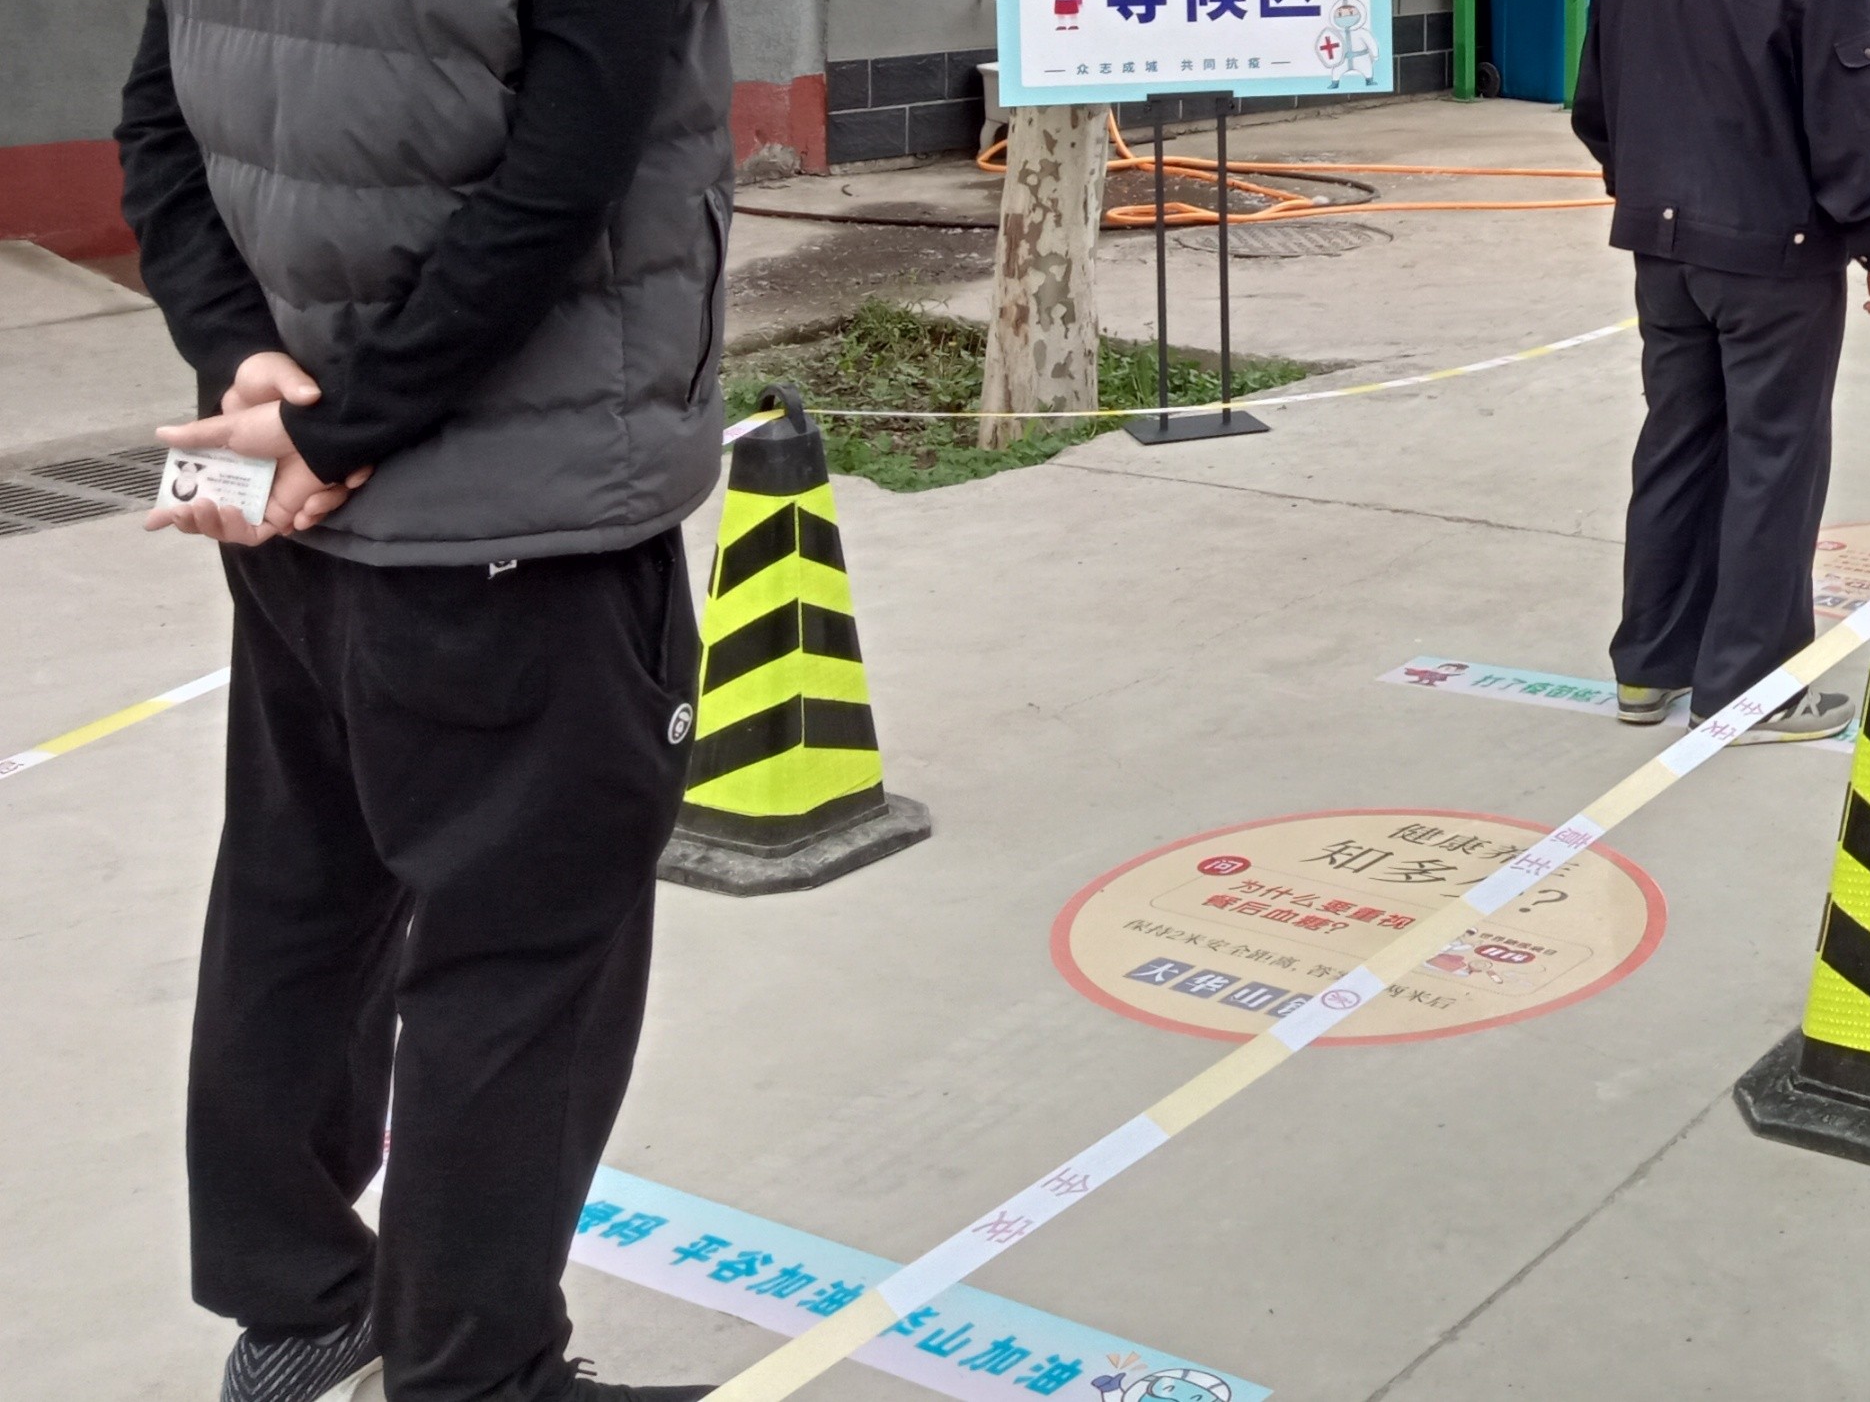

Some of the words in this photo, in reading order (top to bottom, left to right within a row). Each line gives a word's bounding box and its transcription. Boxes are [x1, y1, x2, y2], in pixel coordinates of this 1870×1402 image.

[1076, 59, 1159, 76] 众志成城
[1180, 57, 1262, 73] 共同抗疫
[1203, 859, 1244, 875] 问
[1228, 879, 1416, 931] 为什么要重视
[669, 1233, 866, 1318] 平谷加油
